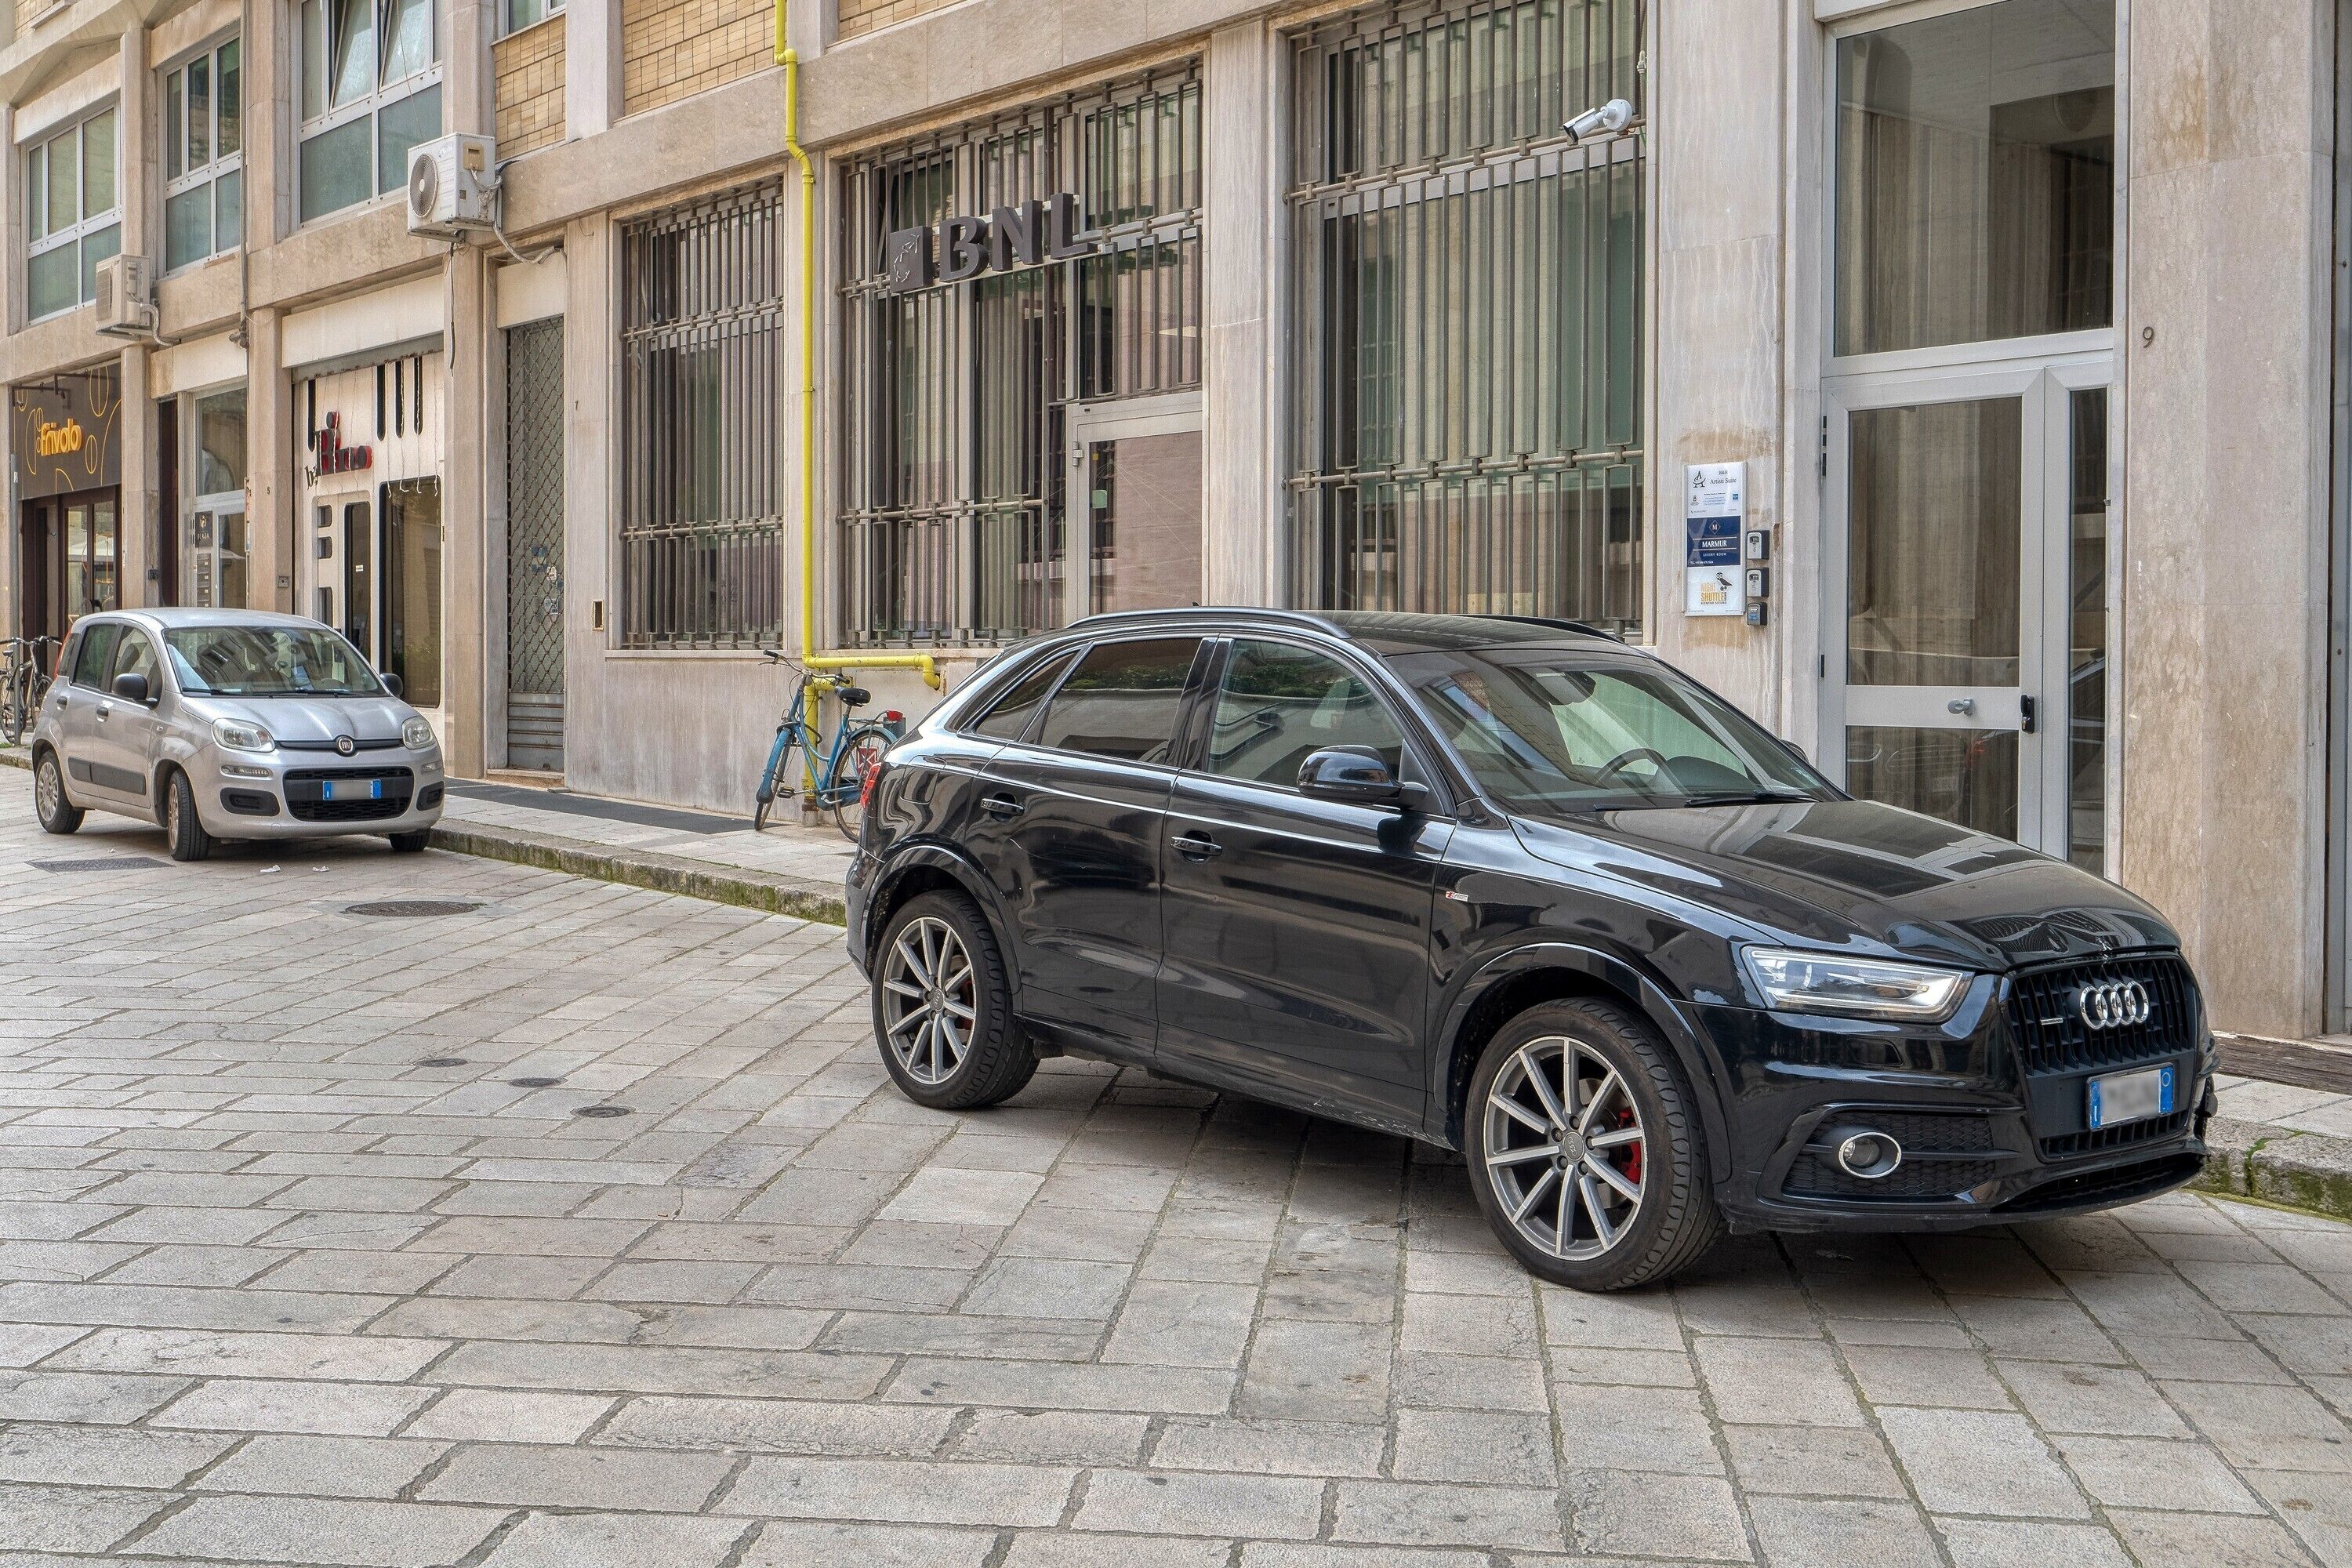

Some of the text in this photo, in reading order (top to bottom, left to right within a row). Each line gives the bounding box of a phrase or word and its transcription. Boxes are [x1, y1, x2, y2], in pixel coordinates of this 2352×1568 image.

[939, 193, 1098, 282] BNL
[2142, 326, 2154, 349] 9
[41, 418, 82, 456] frivolo
[1700, 592, 1724, 602] SHUTTLE
